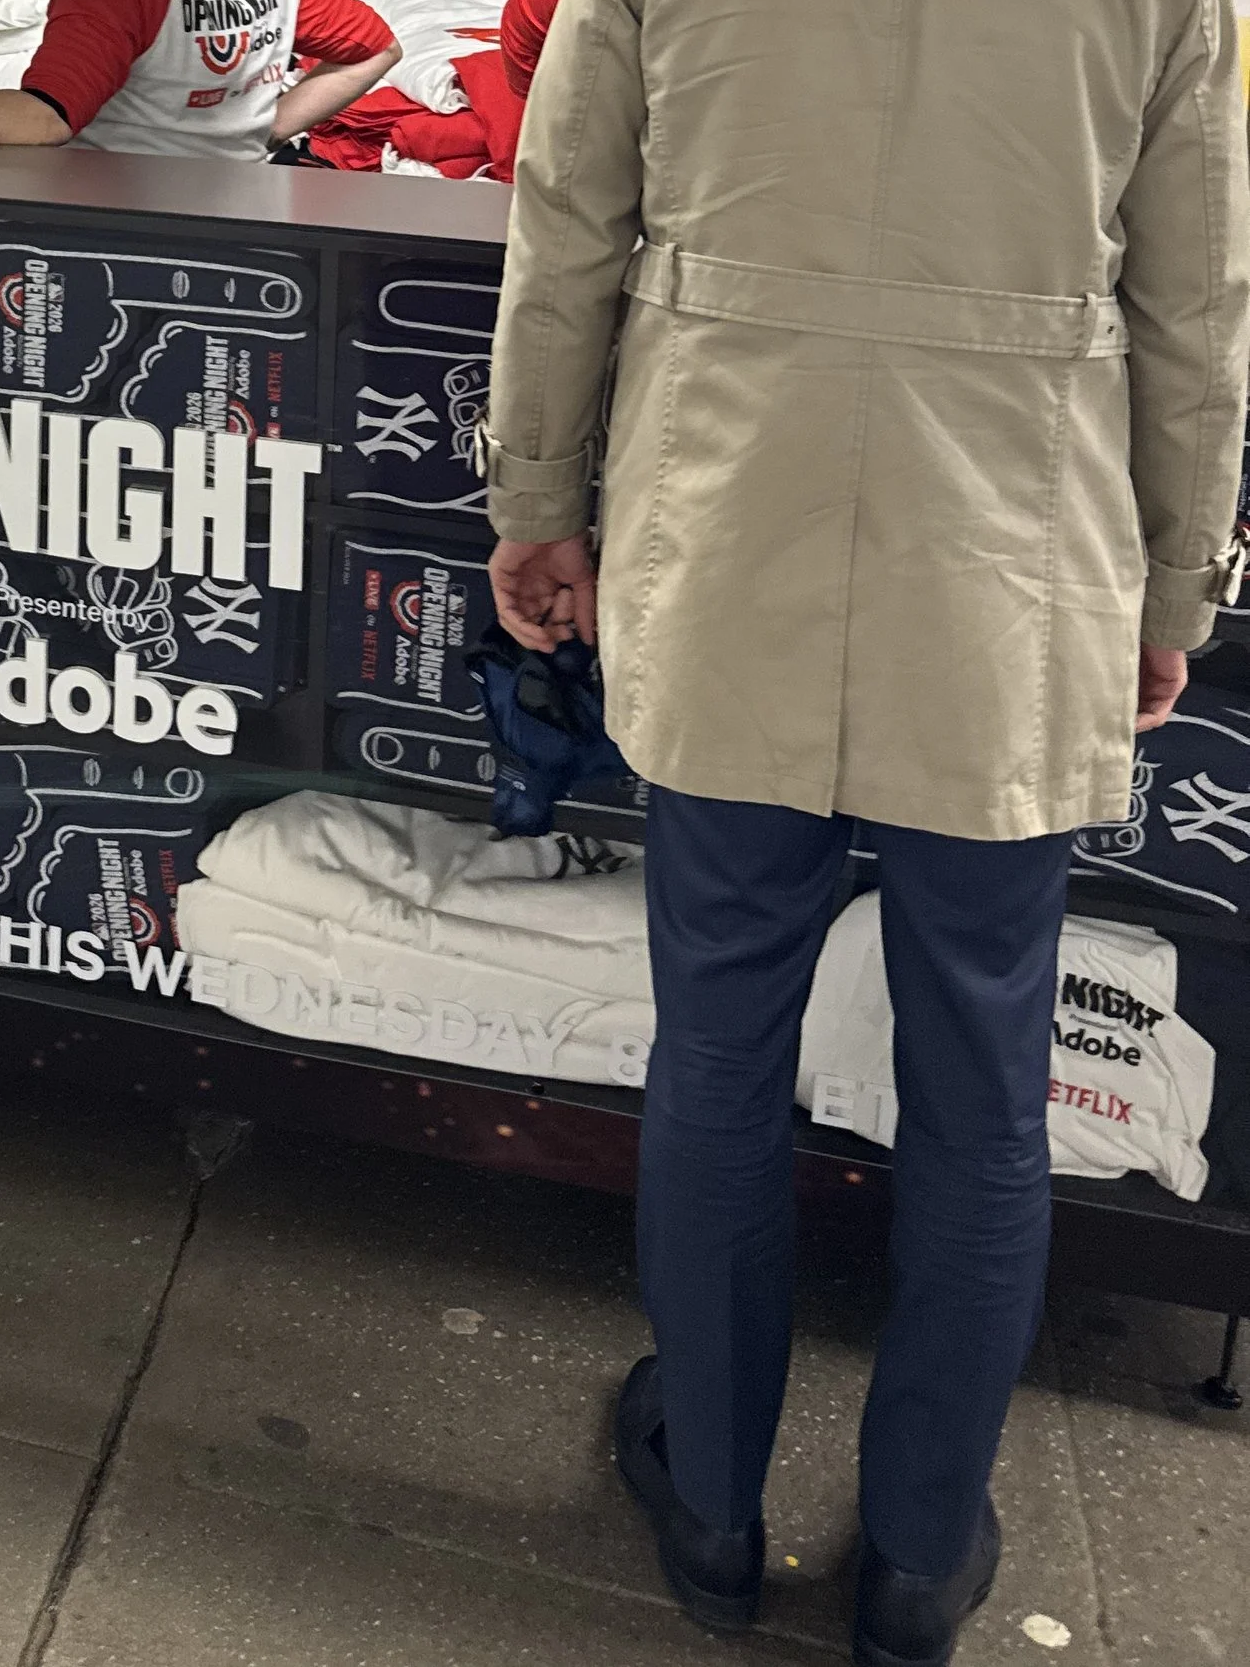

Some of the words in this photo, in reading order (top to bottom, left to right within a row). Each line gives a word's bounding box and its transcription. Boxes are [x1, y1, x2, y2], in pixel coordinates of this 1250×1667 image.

[23, 258, 49, 335] OPENING
[2, 325, 18, 374] Adobe
[22, 335, 48, 388] NIGHT
[202, 335, 229, 389] NIGHT
[235, 349, 251, 400] Adobe
[267, 350, 284, 402] NETFLIX
[120, 605, 152, 633] by
[419, 567, 450, 648] OPENING
[360, 630, 379, 681] NETFLIX
[393, 634, 412, 686] Adobe
[416, 646, 446, 703] NIGHT
[96, 837, 126, 890] NIGHT
[130, 849, 148, 896] Adobe
[121, 941, 578, 1069] WEDNESDAY
[1047, 1077, 1134, 1126] ETFLIX
